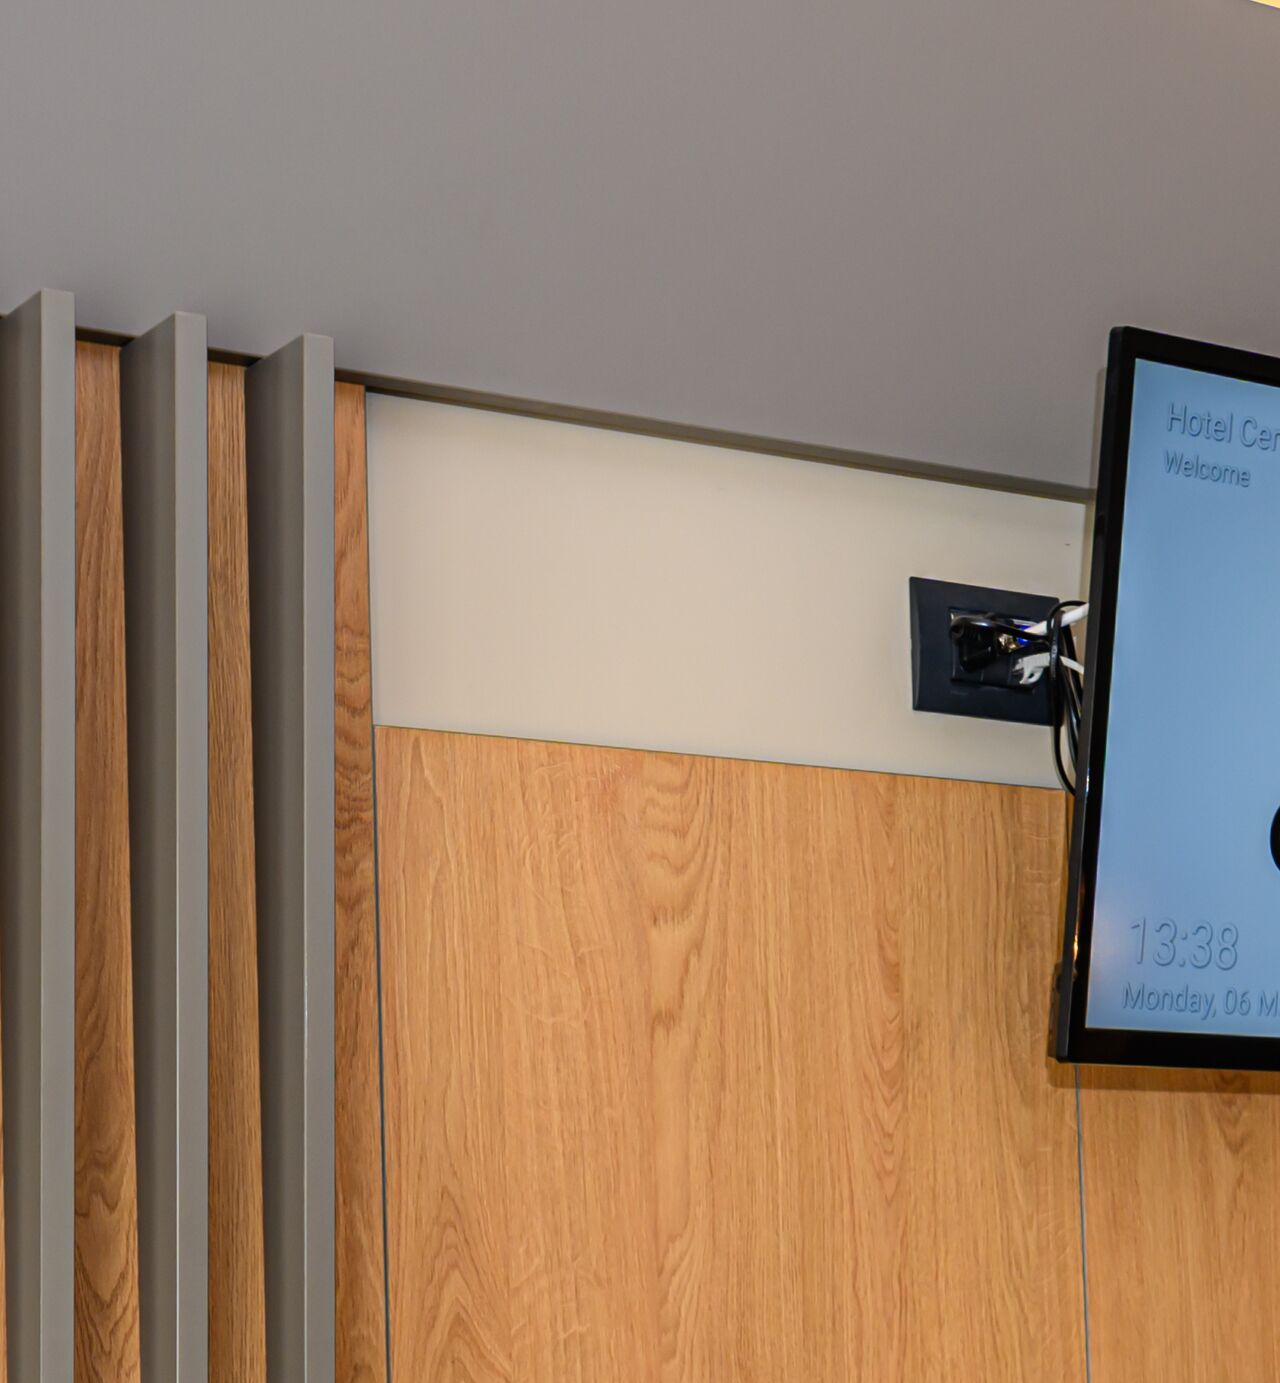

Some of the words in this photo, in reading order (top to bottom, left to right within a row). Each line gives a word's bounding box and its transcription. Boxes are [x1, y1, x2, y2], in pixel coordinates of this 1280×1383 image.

[1166, 401, 1234, 443] Hotel
[1164, 449, 1251, 488] Welcome
[1130, 917, 1239, 971] 13:38
[1122, 981, 1217, 1021] Monday,
[1224, 988, 1252, 1017] 06
